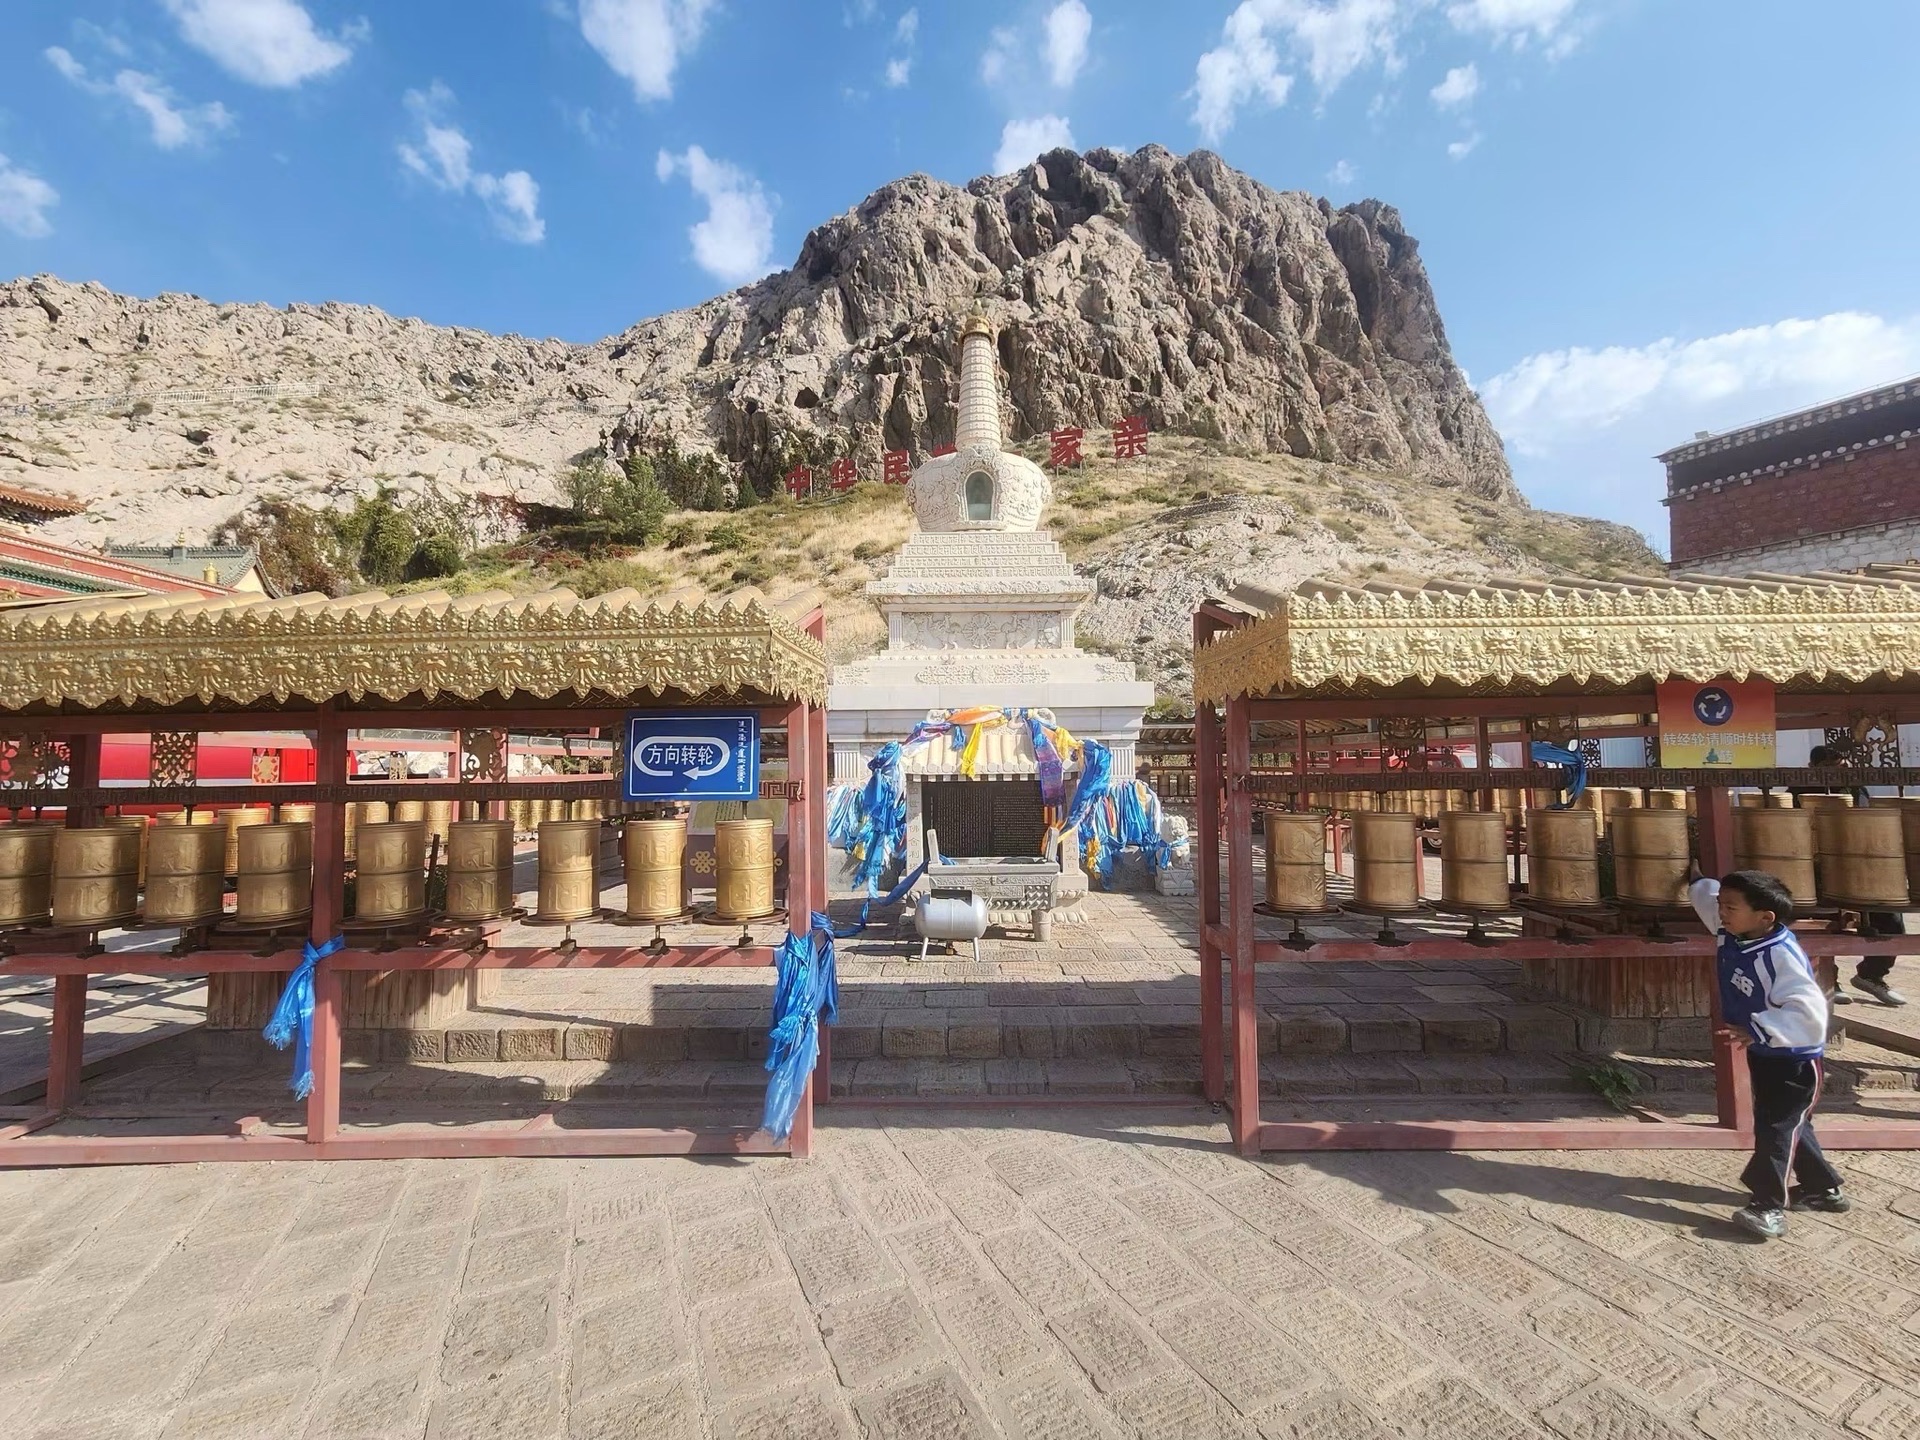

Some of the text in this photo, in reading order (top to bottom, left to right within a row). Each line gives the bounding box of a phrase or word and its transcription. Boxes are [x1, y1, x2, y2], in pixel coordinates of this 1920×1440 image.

[785, 416, 1148, 499] 中华民家亲
[1663, 732, 1775, 746] 转经轮请顺时针转
[647, 744, 714, 766] 方向转轮
